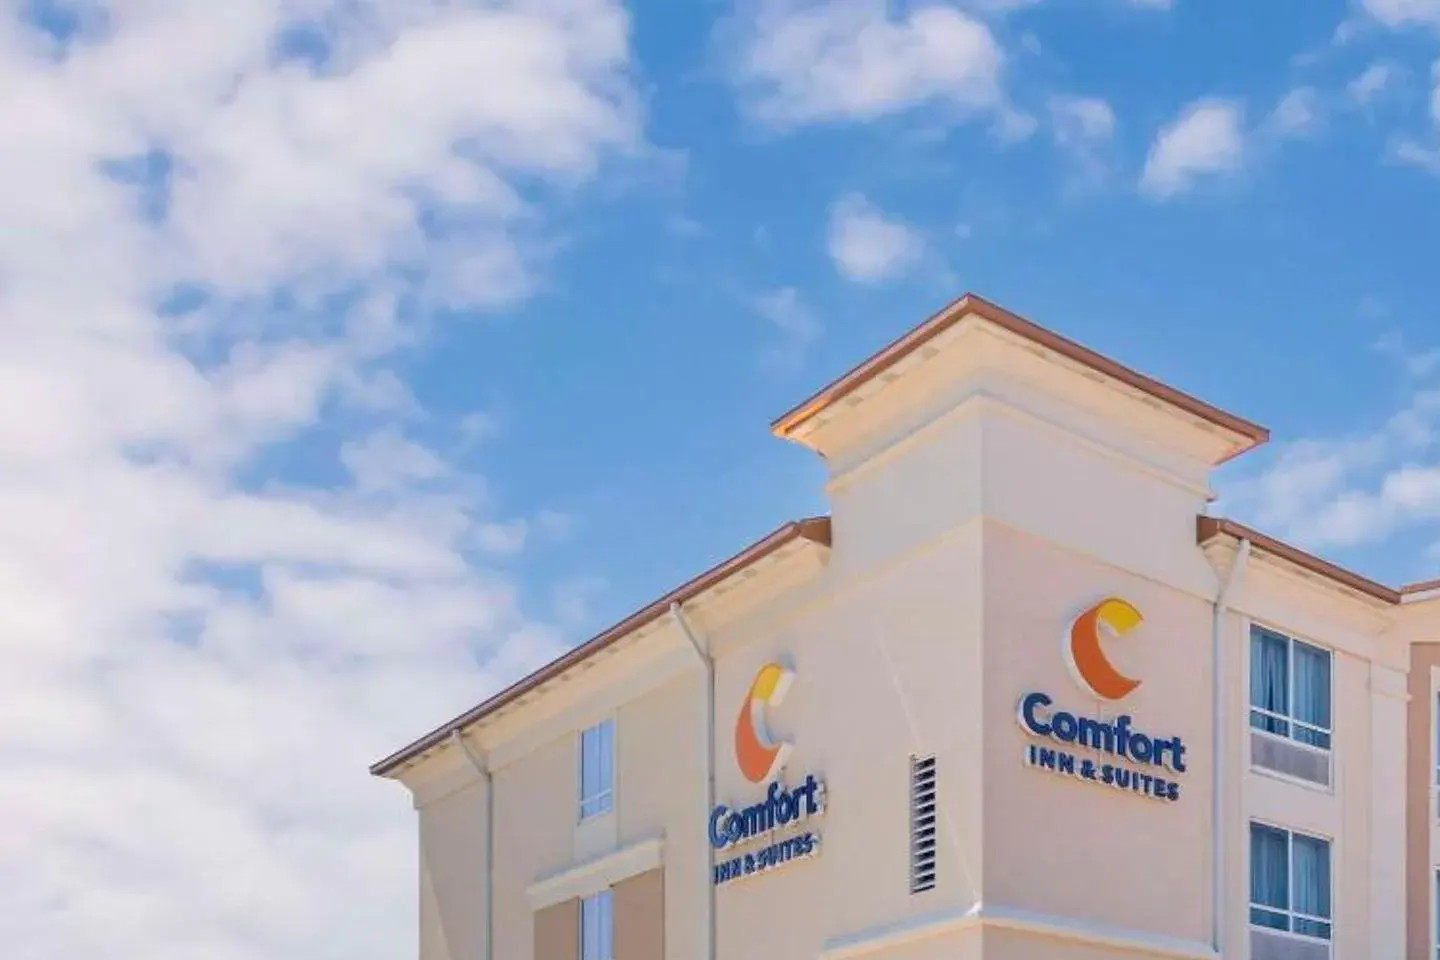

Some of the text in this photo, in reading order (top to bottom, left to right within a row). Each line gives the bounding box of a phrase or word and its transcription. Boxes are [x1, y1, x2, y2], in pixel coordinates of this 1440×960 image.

[1021, 692, 1187, 773] Comfort
[1028, 744, 1180, 802] INN & SUITES
[708, 774, 819, 850] Comfort
[714, 857, 742, 885] INN
[756, 832, 814, 871] SUITES
